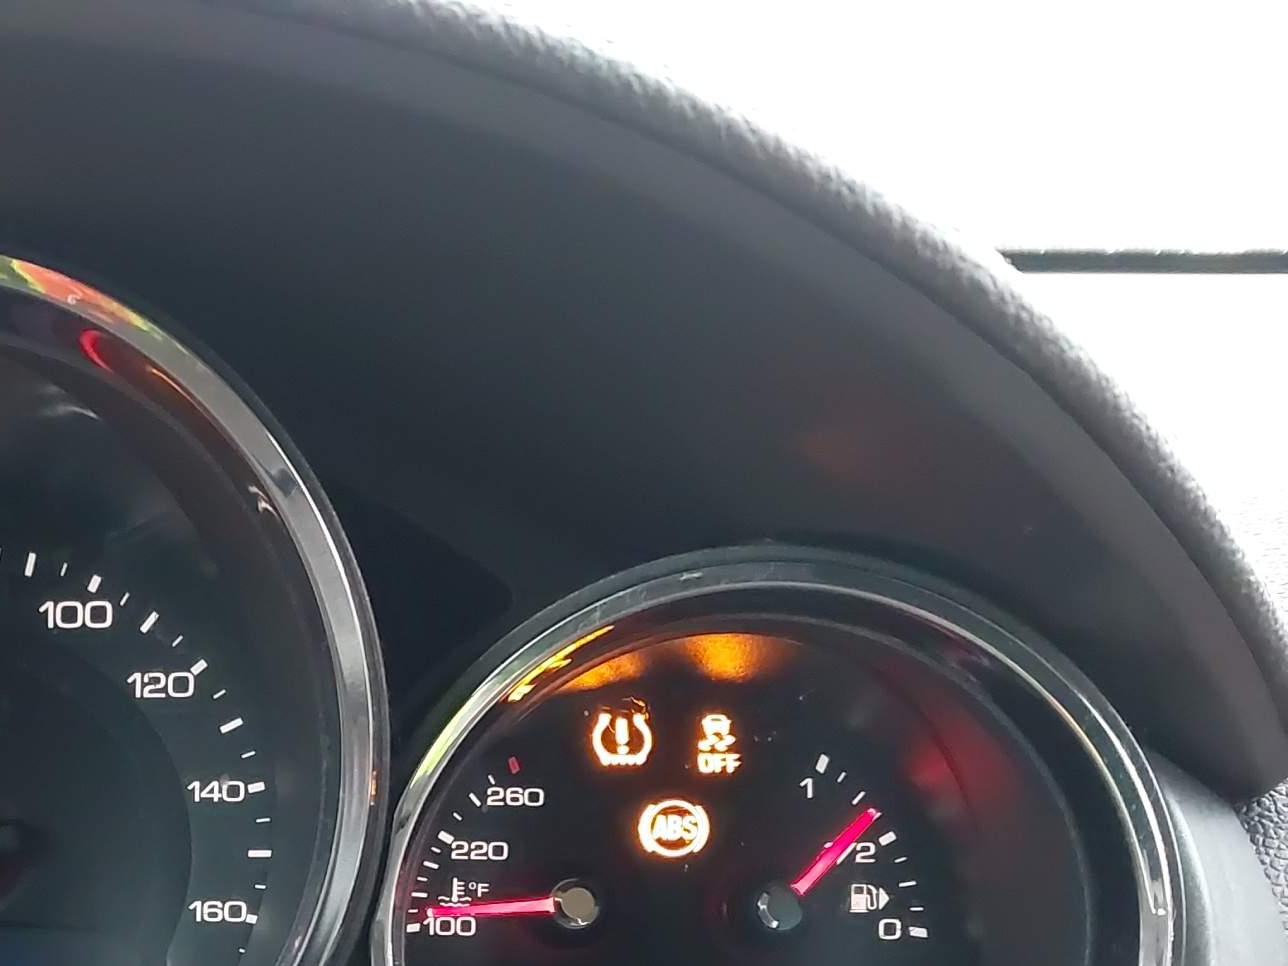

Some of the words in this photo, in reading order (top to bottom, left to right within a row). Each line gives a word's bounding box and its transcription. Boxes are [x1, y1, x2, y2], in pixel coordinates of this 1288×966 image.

[38, 600, 113, 629] 100
[126, 671, 194, 699] 120
[697, 753, 742, 773] OFF
[187, 780, 245, 802] 140
[486, 786, 545, 807] 260
[799, 777, 814, 799] 1
[652, 814, 698, 840] ABS
[450, 840, 509, 861] 220
[188, 900, 246, 923] 160
[423, 915, 476, 936] 100
[878, 918, 902, 940] 0
